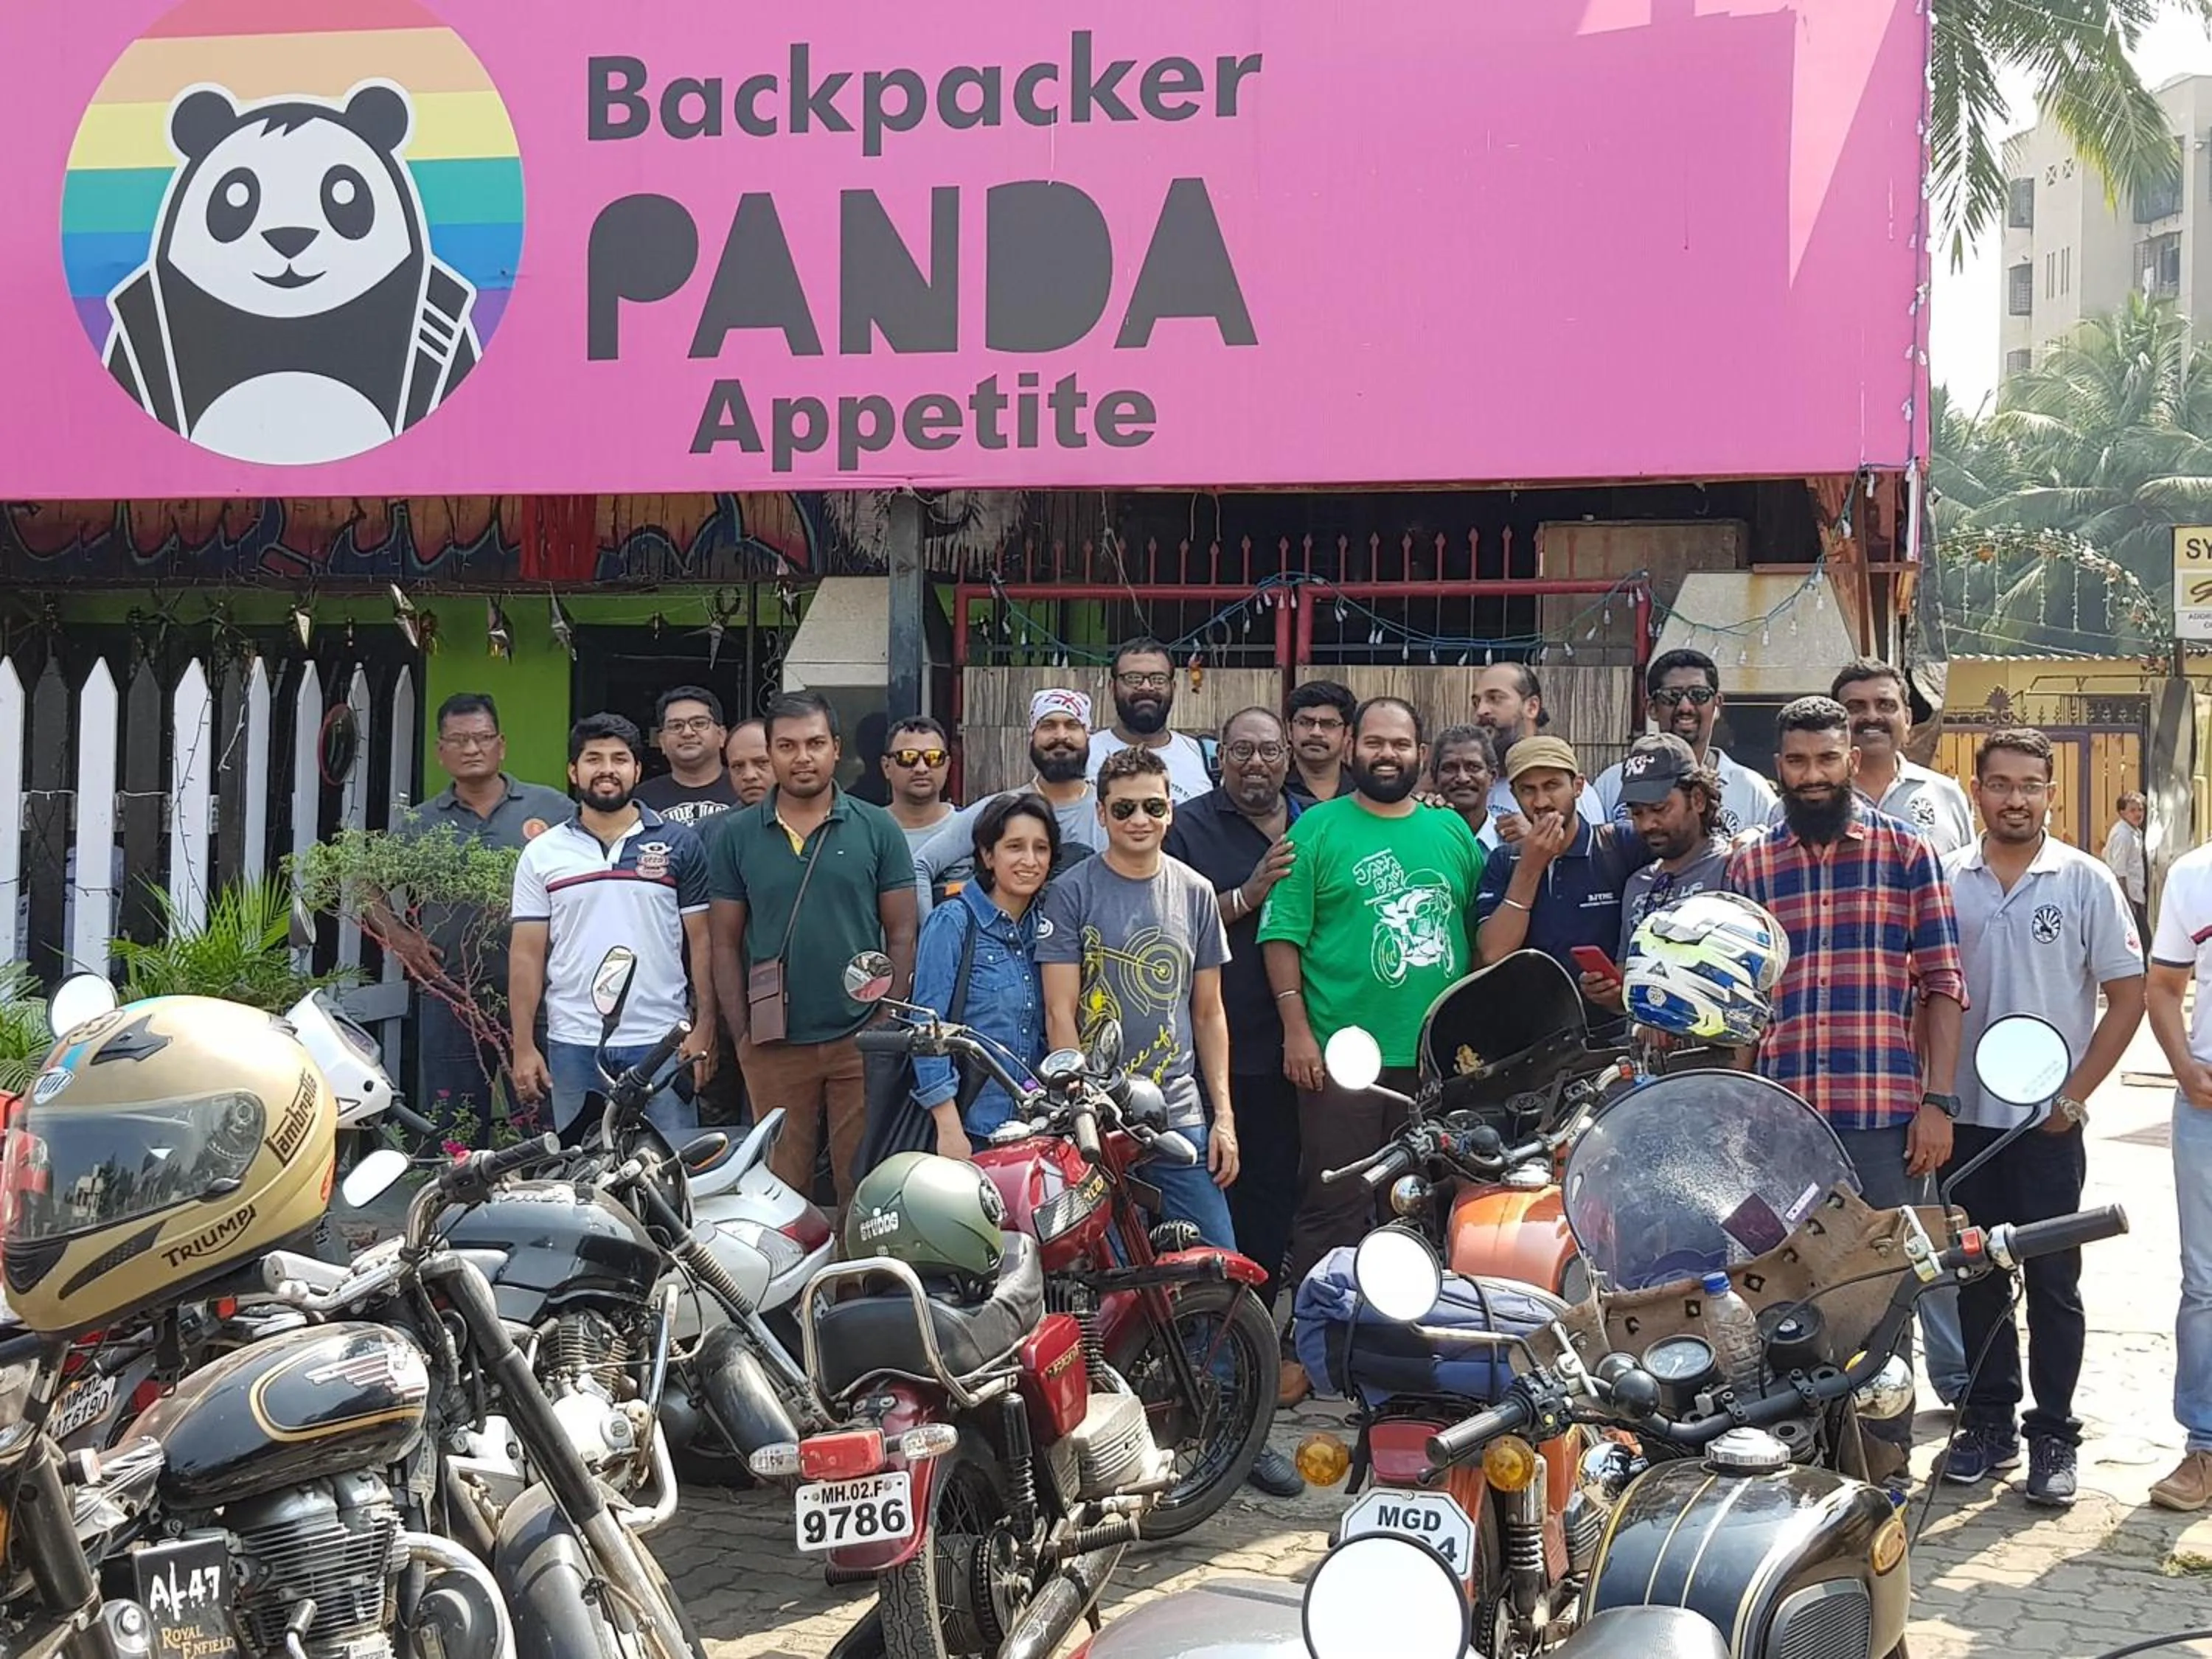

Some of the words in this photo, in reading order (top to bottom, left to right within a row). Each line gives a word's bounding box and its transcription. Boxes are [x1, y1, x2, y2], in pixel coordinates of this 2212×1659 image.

[587, 29, 1263, 157] Backpacker
[587, 177, 1259, 361] PANDA
[689, 372, 1157, 473] Appetite
[803, 1498, 906, 1543] 9786
[1377, 1505, 1441, 1531] MGD
[161, 1624, 204, 1649] ROYAL
[181, 1636, 236, 1659] ENFIELD
